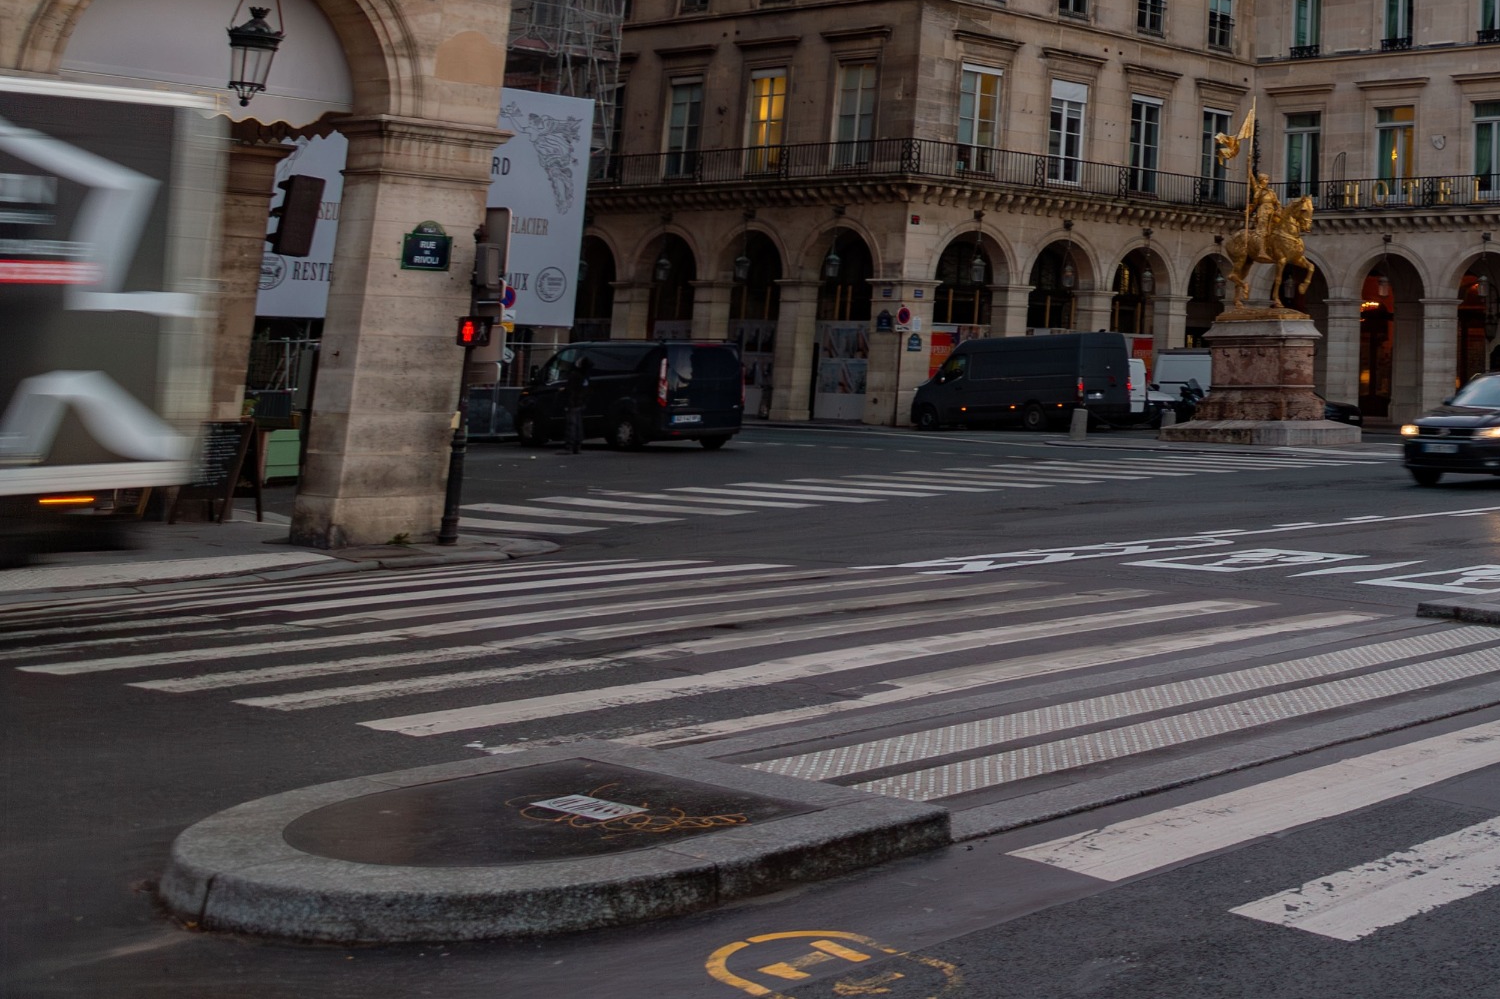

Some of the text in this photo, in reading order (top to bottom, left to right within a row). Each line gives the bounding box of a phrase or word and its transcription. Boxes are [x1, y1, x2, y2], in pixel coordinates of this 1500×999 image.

[1343, 176, 1488, 208] HOTEL
[419, 240, 437, 249] RUE
[413, 255, 440, 265] RIVOLI
